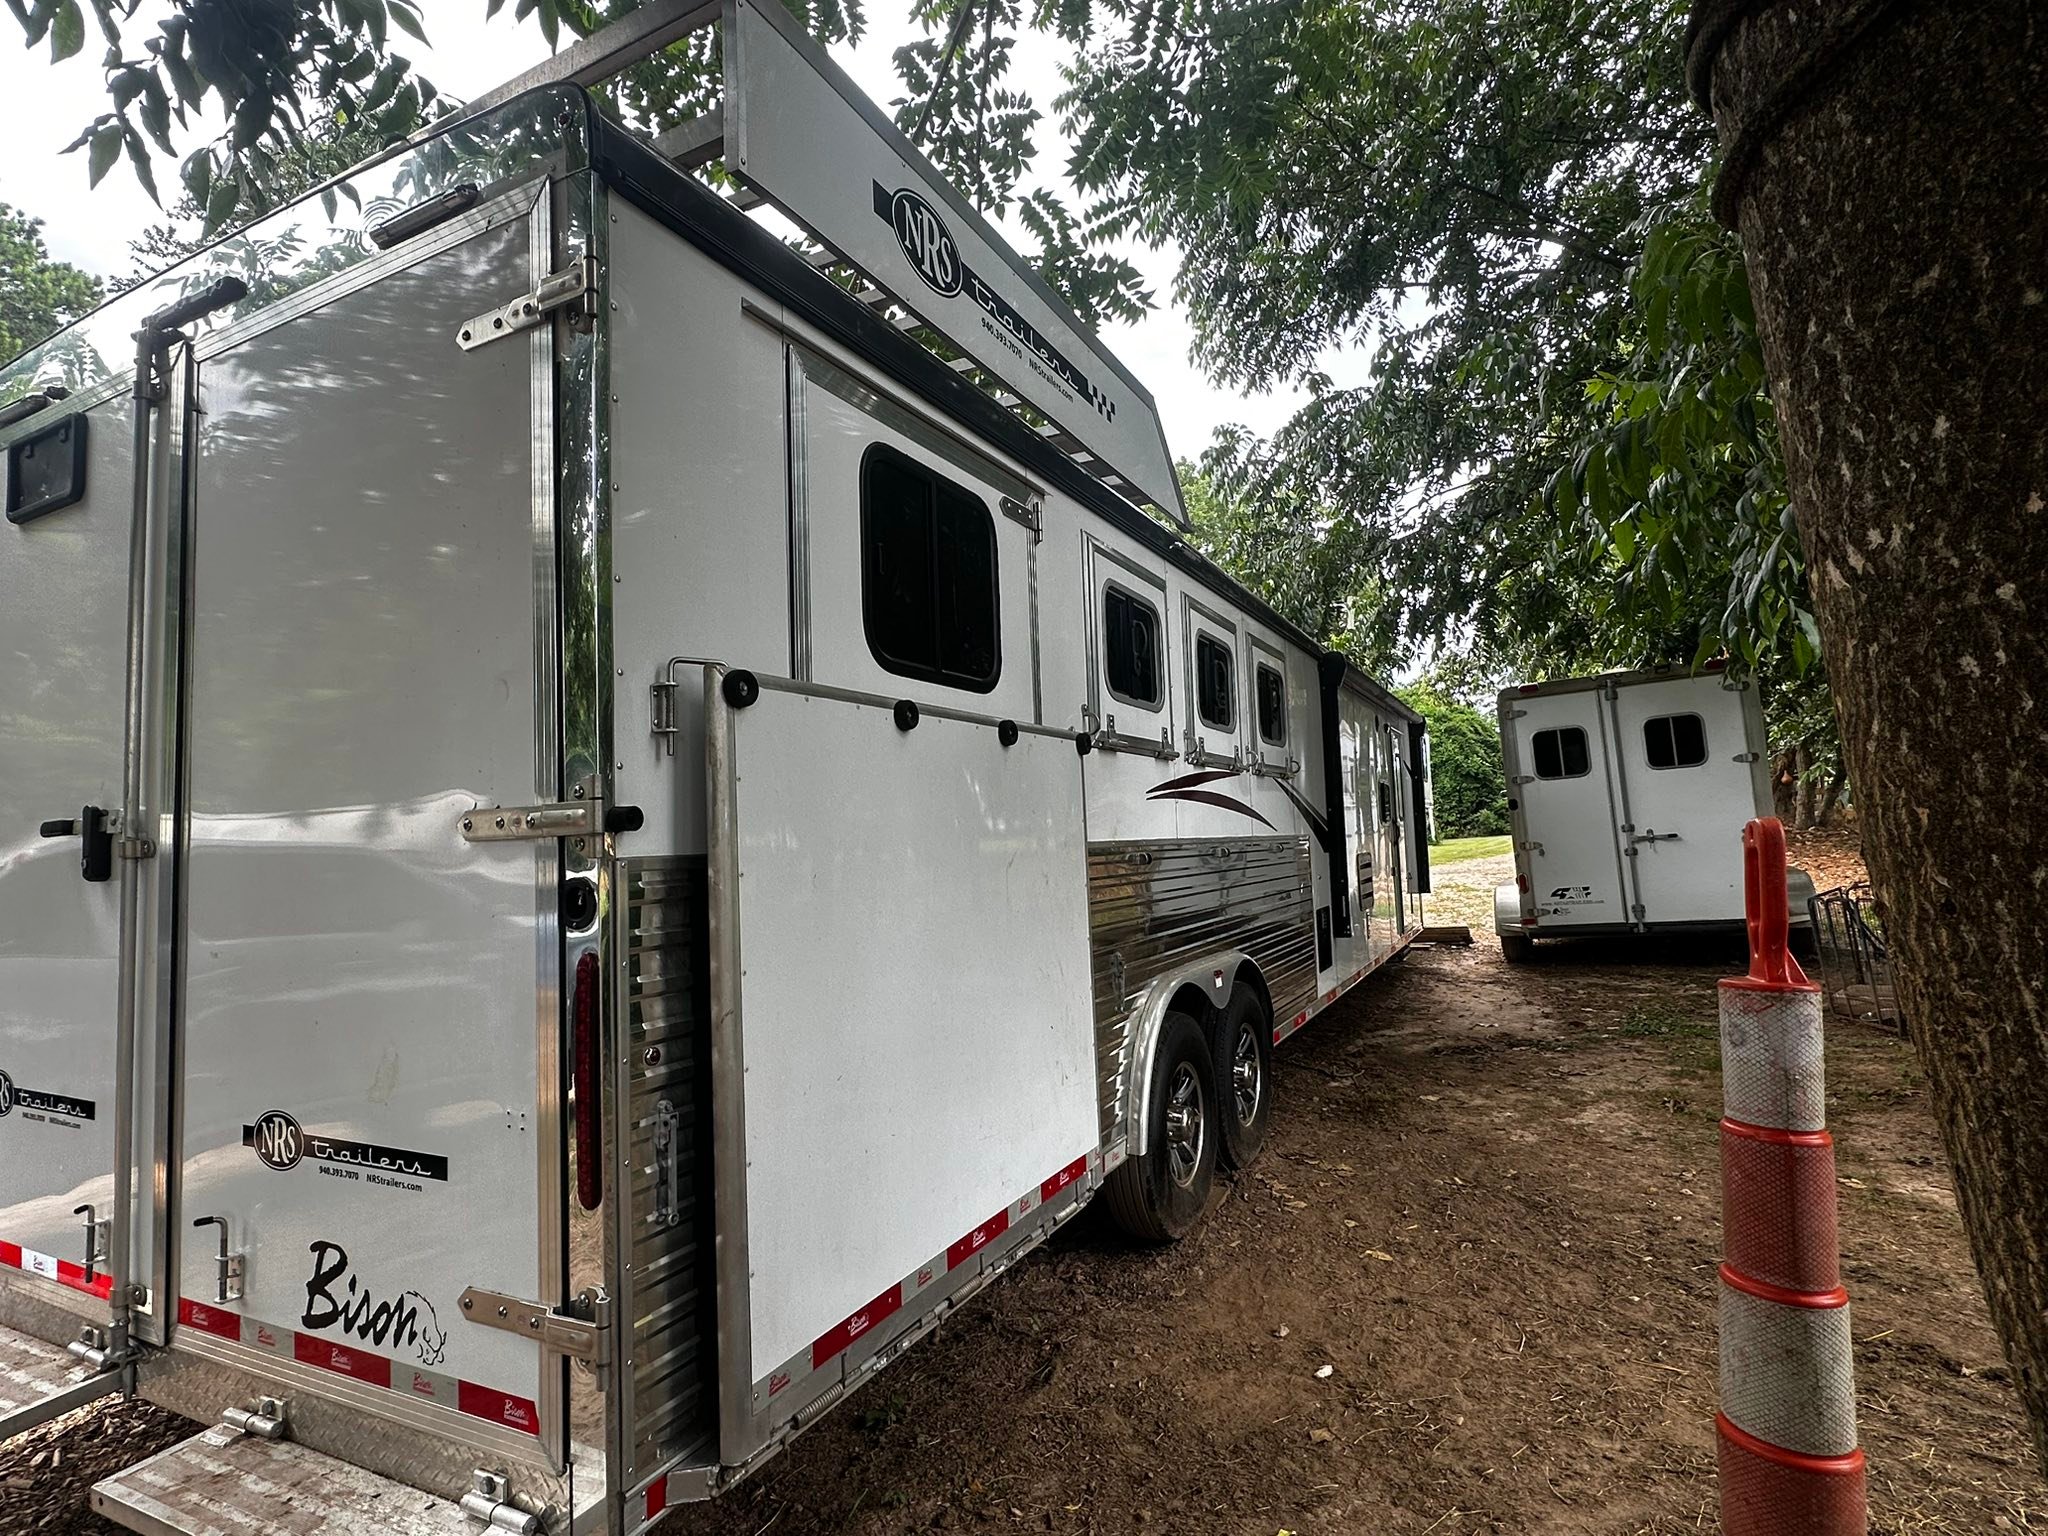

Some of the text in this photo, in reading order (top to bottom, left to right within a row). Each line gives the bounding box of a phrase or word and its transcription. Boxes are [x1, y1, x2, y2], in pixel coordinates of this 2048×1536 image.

[903, 198, 1079, 391] NRS trailers
[980, 317, 1074, 403] 940.393.7070 NRStrailers.com
[18, 1089, 87, 1117] trailers
[261, 1116, 432, 1176] NRS trailers
[318, 1165, 423, 1192] 940.393.7070 NRStrailers.com
[301, 1239, 419, 1348] Bison
